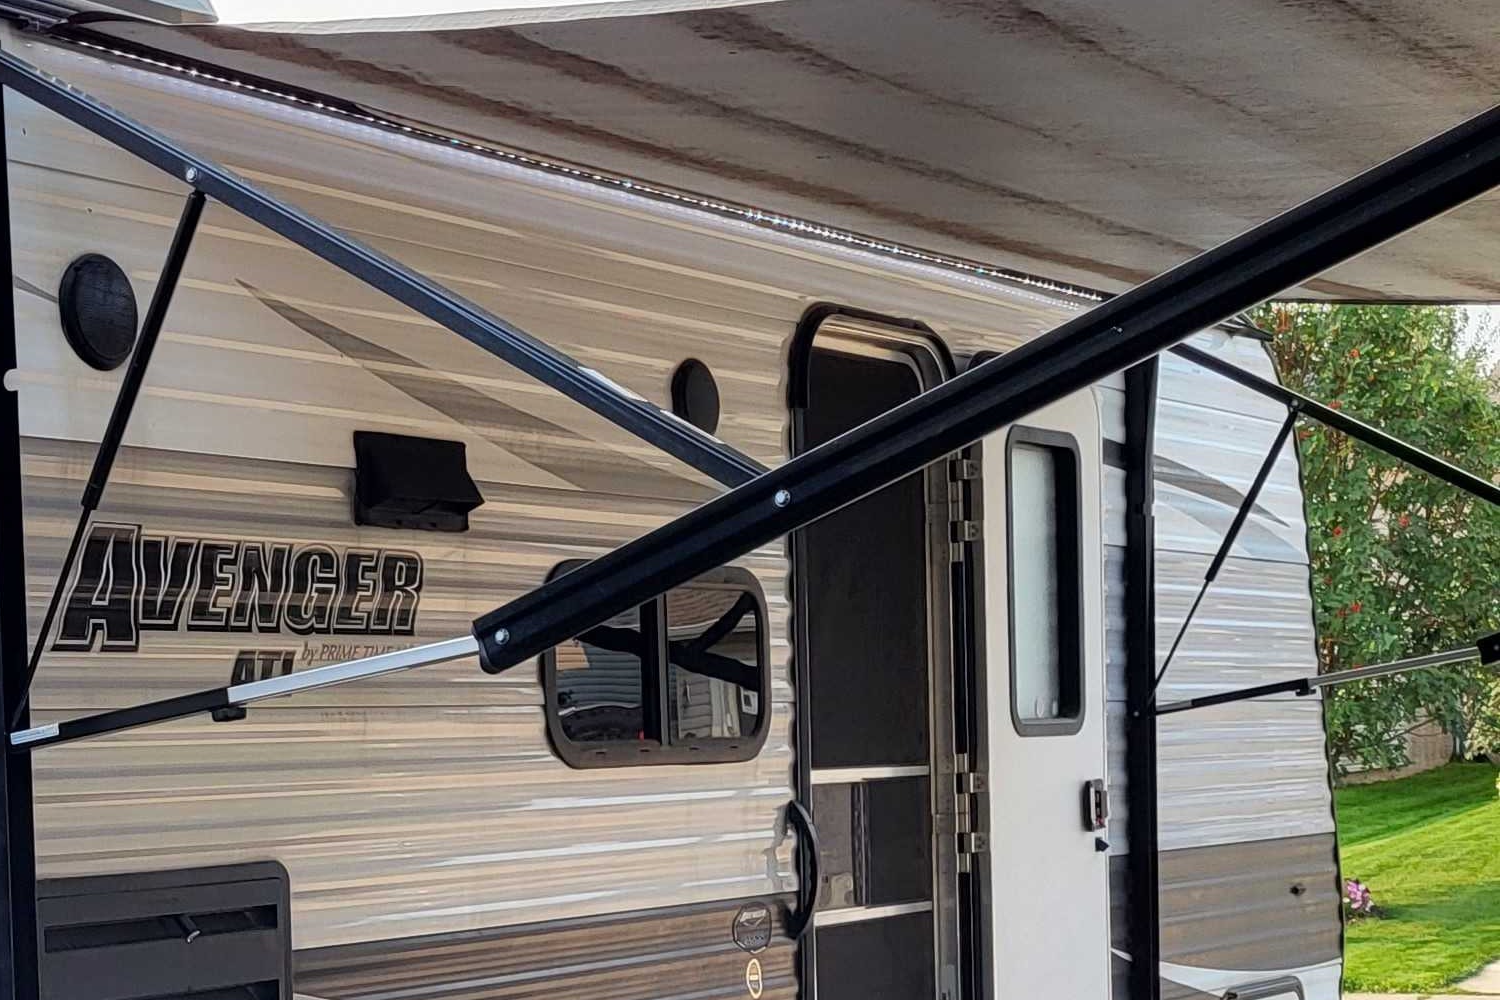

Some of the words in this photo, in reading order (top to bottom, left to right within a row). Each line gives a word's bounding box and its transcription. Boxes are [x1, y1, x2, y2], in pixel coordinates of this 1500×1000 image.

[51, 520, 423, 651] AVENGER
[301, 640, 318, 666] by
[320, 643, 360, 661] PRIME
